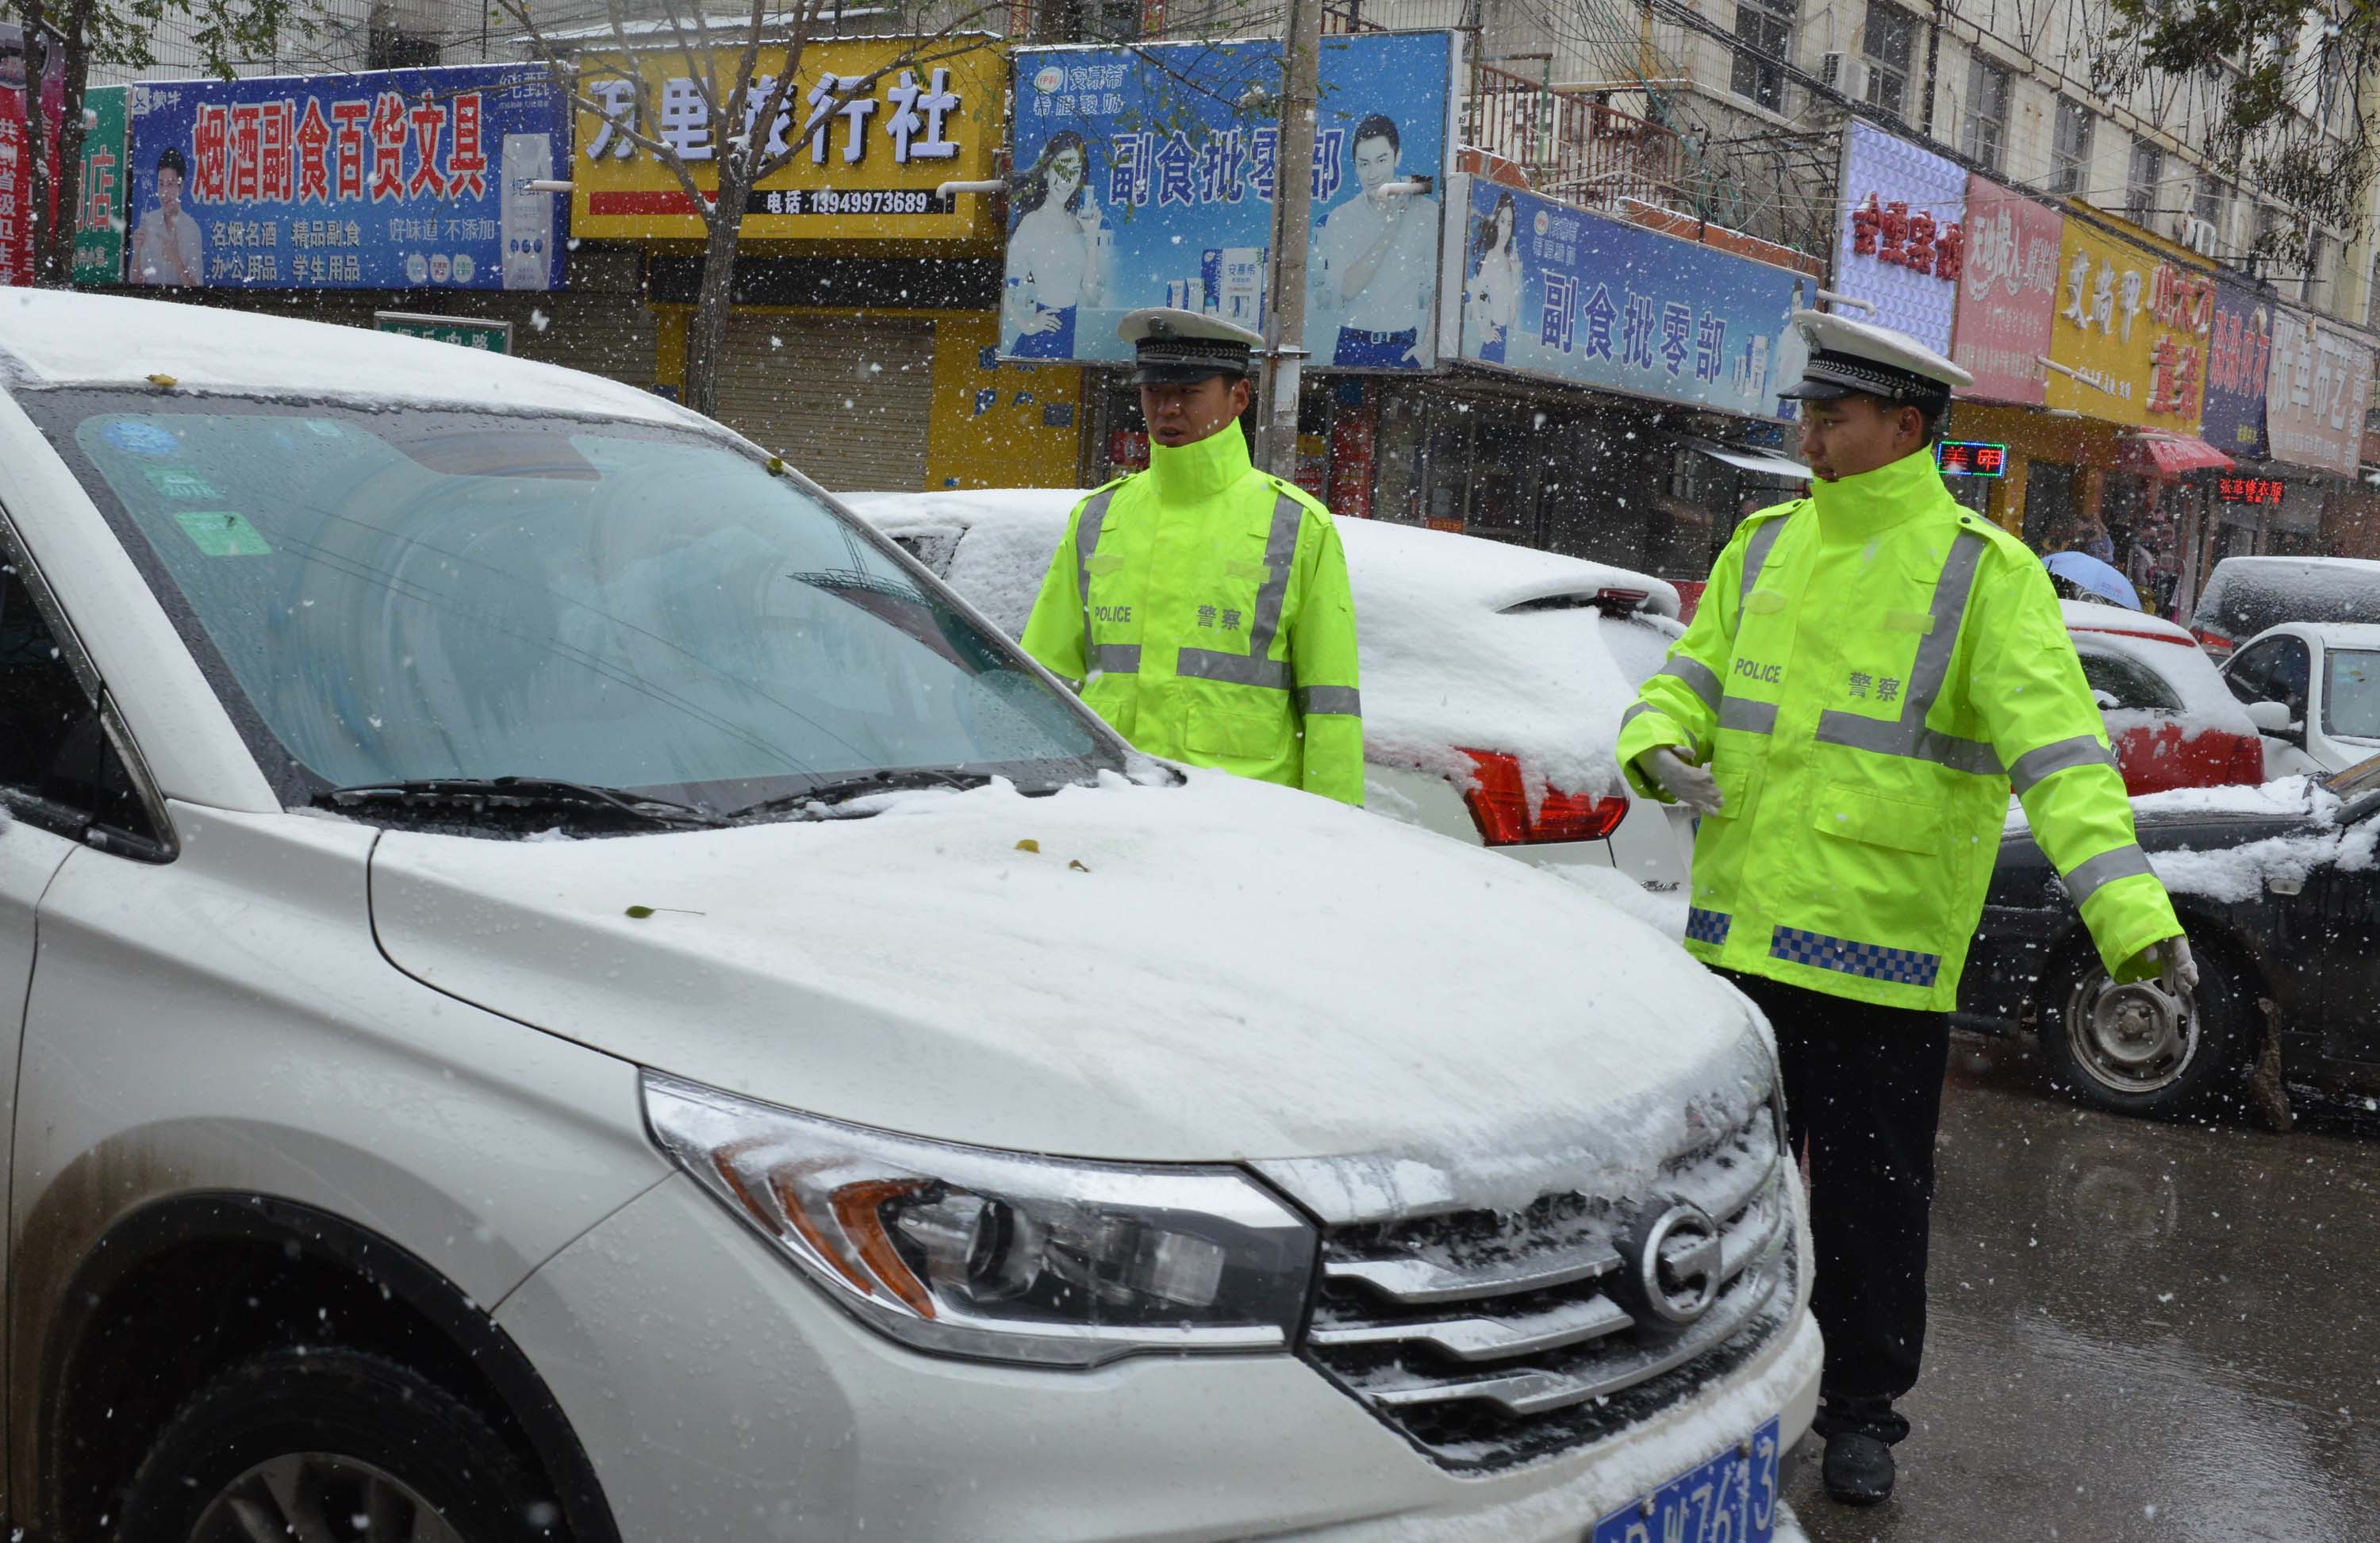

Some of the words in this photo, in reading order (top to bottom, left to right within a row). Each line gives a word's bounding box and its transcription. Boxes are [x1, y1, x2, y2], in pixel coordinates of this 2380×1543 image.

[1069, 64, 1123, 90] 安慕希
[152, 90, 182, 112] 蒙牛
[192, 90, 488, 206] 烟酒副食百货文具
[1110, 129, 1345, 208] 副食批零部
[767, 191, 801, 214] 电话
[812, 192, 927, 214] 13949973689
[211, 220, 277, 248] 名烟名酒
[291, 220, 361, 248] 精品副食
[389, 217, 438, 241] 好味道
[444, 218, 495, 241] 不添加
[211, 253, 277, 281] 办公用品
[291, 254, 361, 282] 学生用品
[1541, 271, 1728, 385] 副食批零部
[1941, 446, 2002, 471] 美甲
[1095, 605, 1132, 623] POLICE
[1197, 605, 1242, 631] 警察
[1734, 658, 1782, 684] POLICE
[1848, 671, 1901, 702] 警察
